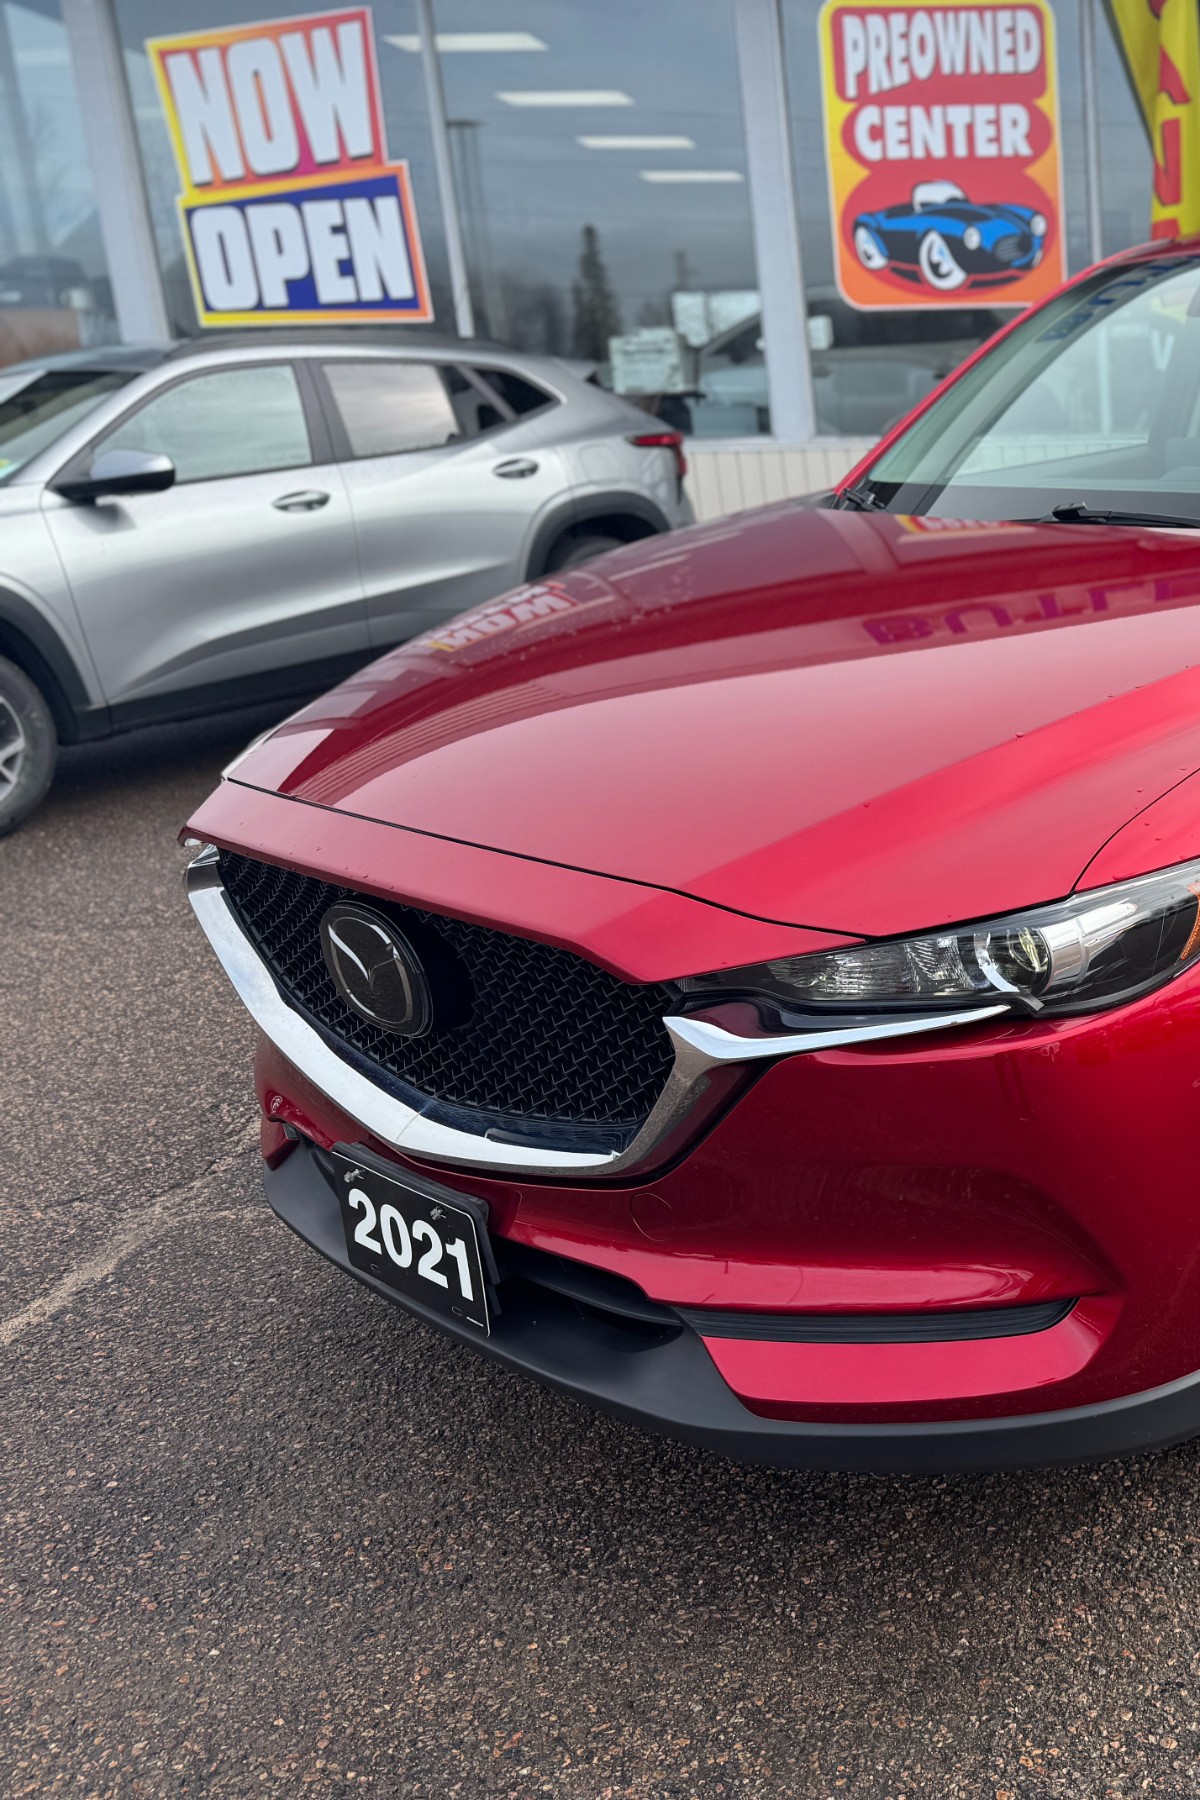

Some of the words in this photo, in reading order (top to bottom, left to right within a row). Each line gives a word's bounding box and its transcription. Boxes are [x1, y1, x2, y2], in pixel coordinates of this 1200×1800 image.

[165, 20, 374, 187] NOW
[842, 9, 1041, 99] PREOWNED
[854, 103, 1034, 162] CENTER
[190, 195, 415, 312] OPEN
[348, 1188, 474, 1302] 2021
